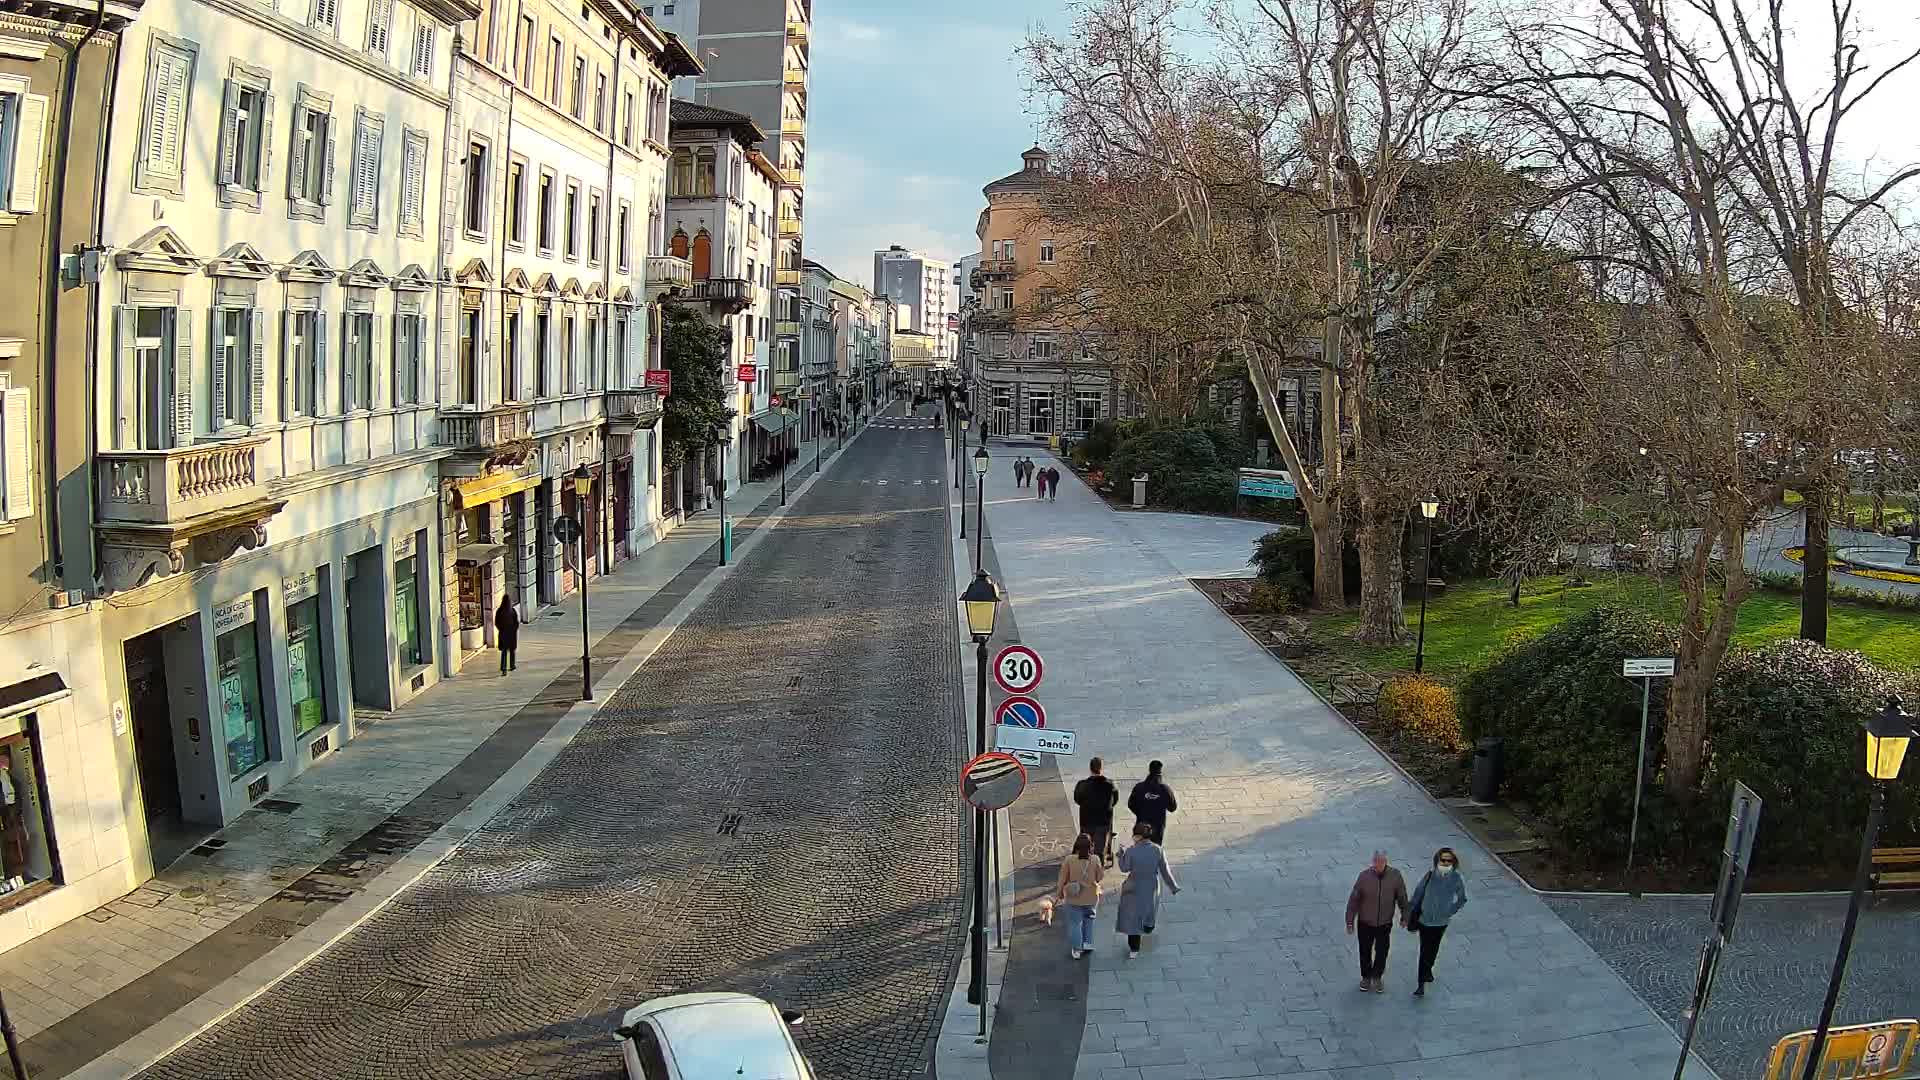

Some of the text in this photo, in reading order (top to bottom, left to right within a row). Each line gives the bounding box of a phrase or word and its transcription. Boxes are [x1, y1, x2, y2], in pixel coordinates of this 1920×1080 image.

[1005, 659, 1033, 680] 30
[222, 678, 240, 701] 130
[1038, 738, 1070, 749] Dante
